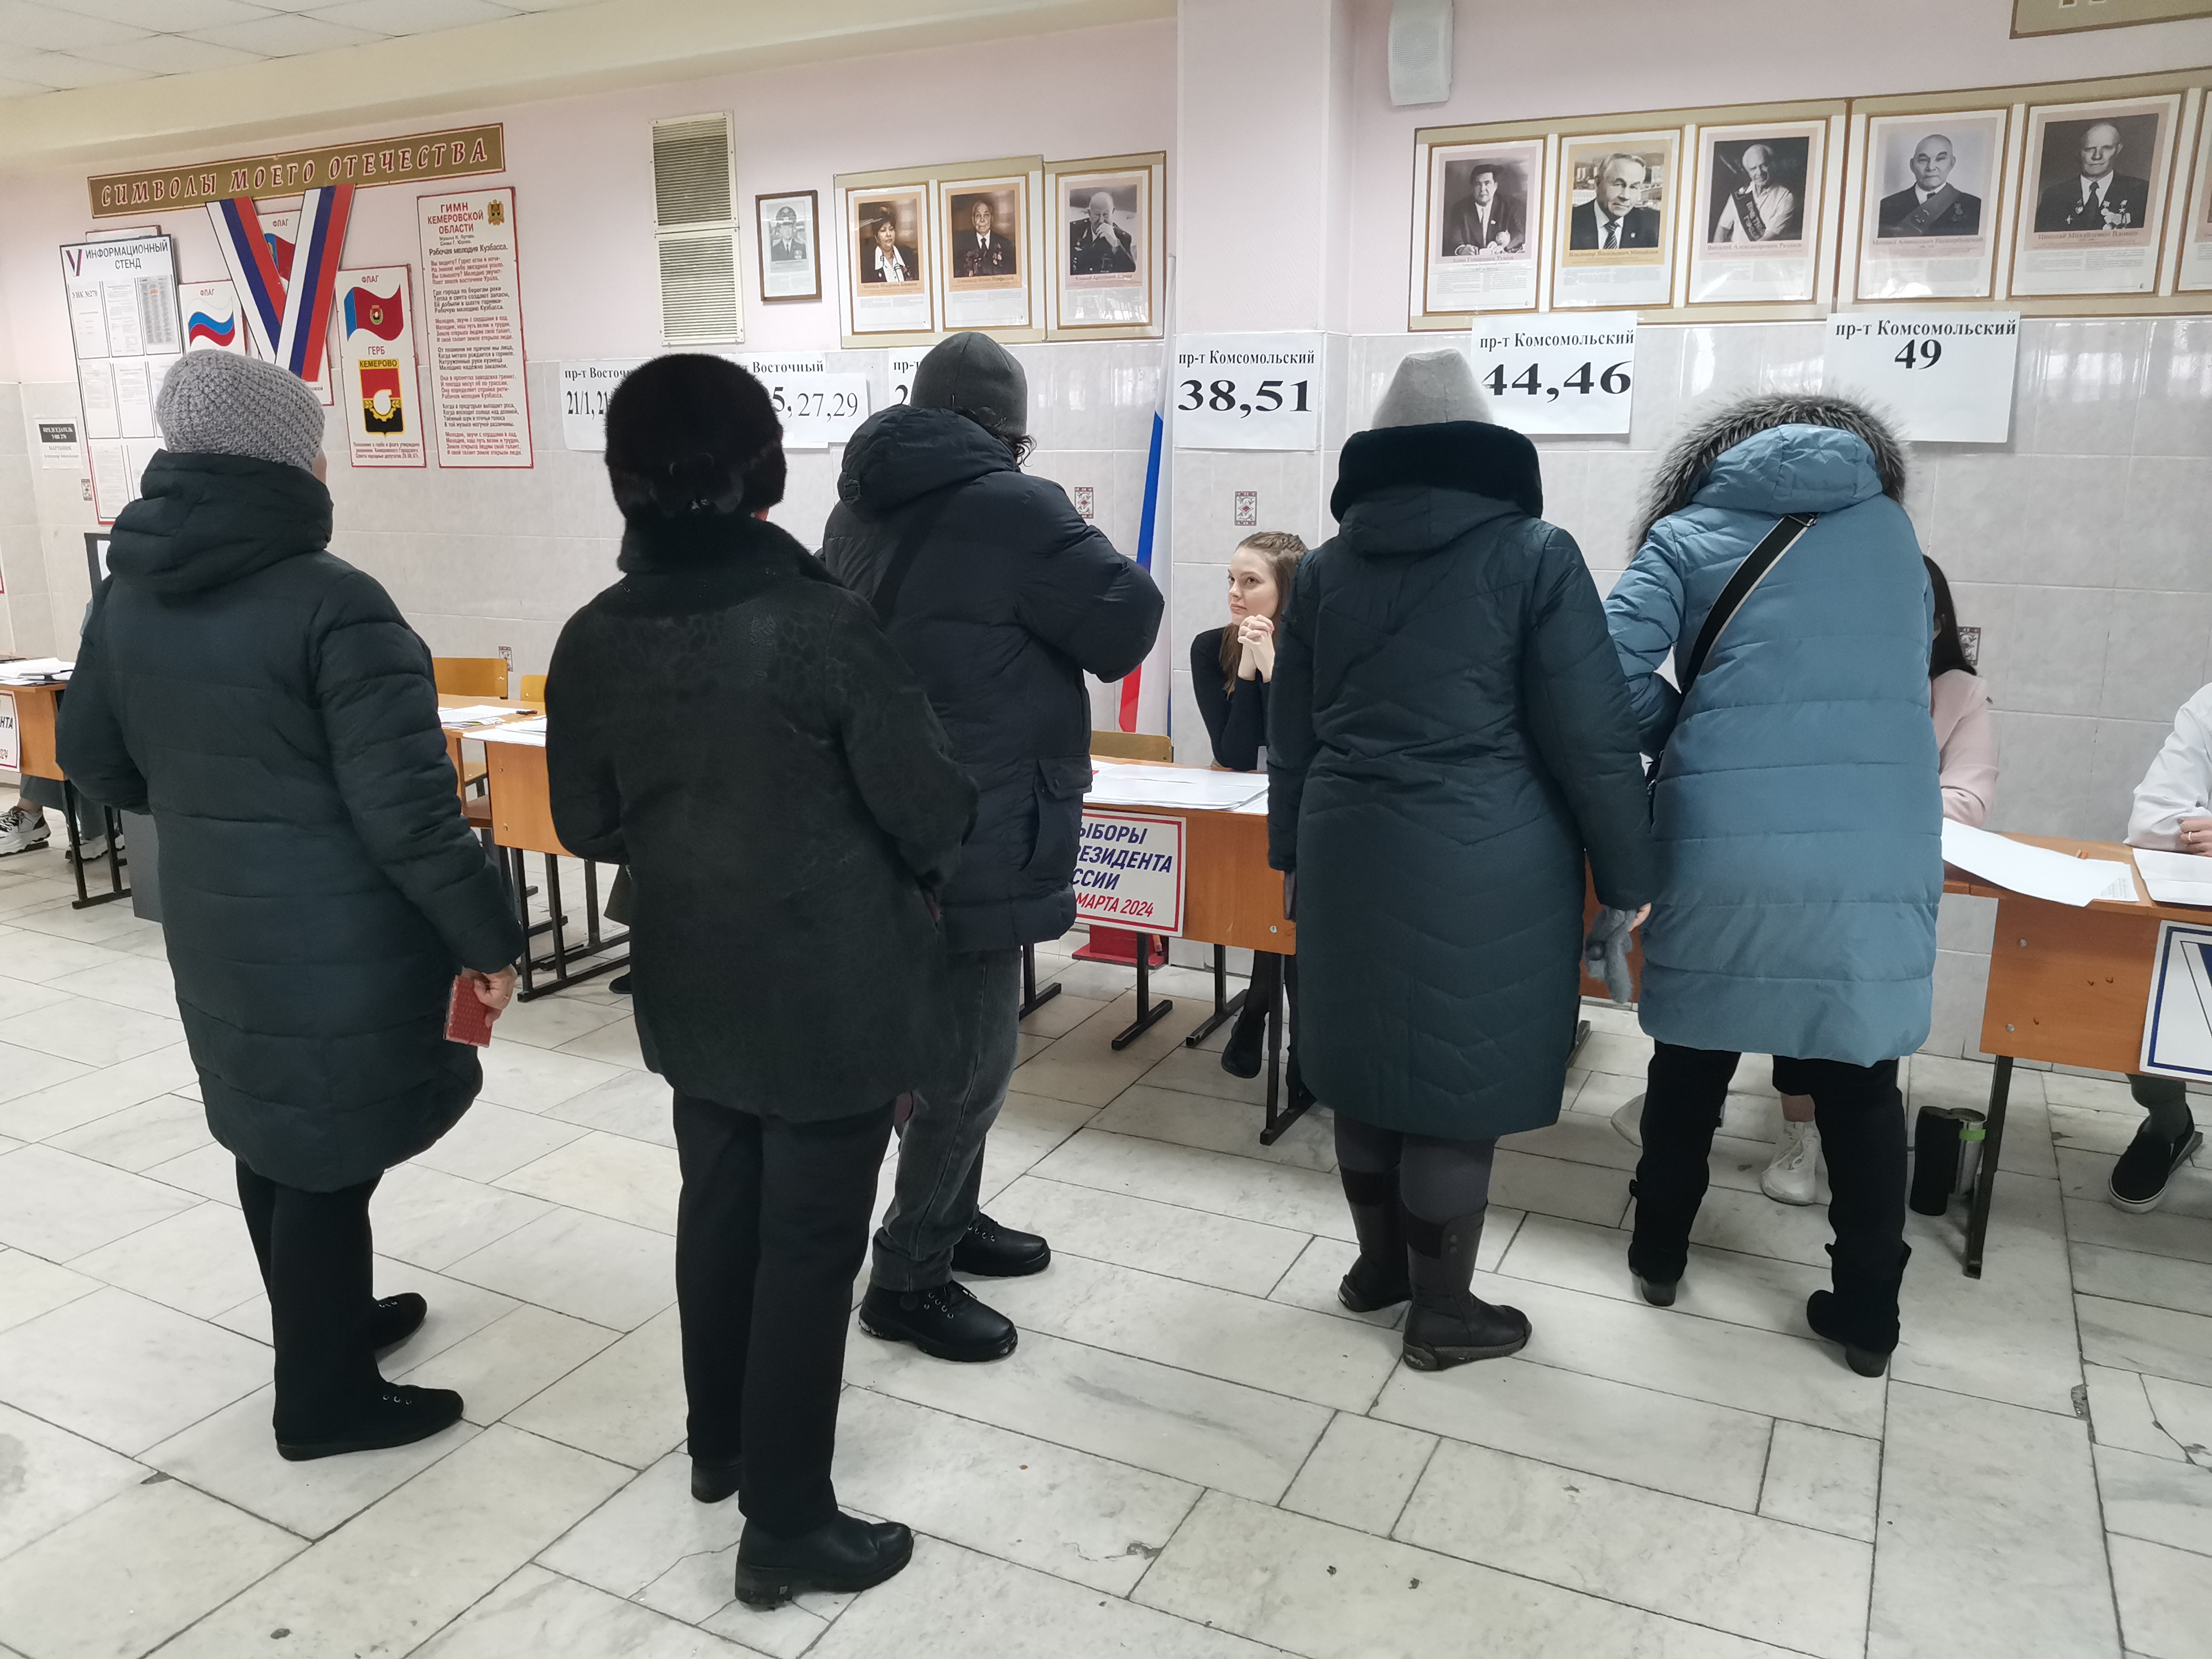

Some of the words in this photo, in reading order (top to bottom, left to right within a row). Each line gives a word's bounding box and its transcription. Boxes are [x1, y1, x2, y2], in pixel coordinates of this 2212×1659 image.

[100, 172, 217, 207] СИМВОЛЫ
[229, 161, 316, 192] МОЕГО
[328, 138, 488, 180] ОТЕЧЕСТВА
[427, 210, 484, 225] КЕМЕРОВСКОЙ
[441, 202, 468, 213] ГИМН
[273, 219, 289, 227] ФЛАГ
[439, 223, 474, 234] ОБЛАСТИ
[85, 239, 168, 259] ИНФОРМАЦИОННЫЙ
[479, 243, 508, 252] Кузбасса.
[114, 258, 142, 269] СТЕНД
[362, 275, 379, 283] ФЛАГ
[1835, 322, 1872, 340] пр-т
[1877, 319, 2016, 336] Комсомольский
[368, 346, 385, 355] ГЕРБ
[1480, 337, 1510, 351] пр-т
[1514, 330, 1635, 348] Комсомольский
[359, 359, 398, 368] КЕМЕРОВО
[1178, 354, 1206, 367] пр-т
[1209, 349, 1316, 364] Комсомольский
[1894, 338, 1942, 370] 49
[565, 370, 586, 381] пр-т
[589, 367, 629, 378] Восточ
[753, 360, 824, 373] Восточный
[1482, 360, 1633, 404] 44,46
[773, 387, 792, 418] 5,
[895, 384, 909, 404] 2
[1178, 379, 1313, 418] 38,51
[566, 390, 594, 420] 21/1,
[1079, 823, 1148, 844] ЫБОРЫ
[1078, 845, 1173, 873] ЕЗИДЕНТА
[1073, 868, 1120, 890] ССИИ
[1076, 893, 1119, 912] МАРТА
[1120, 899, 1154, 917] 2024
